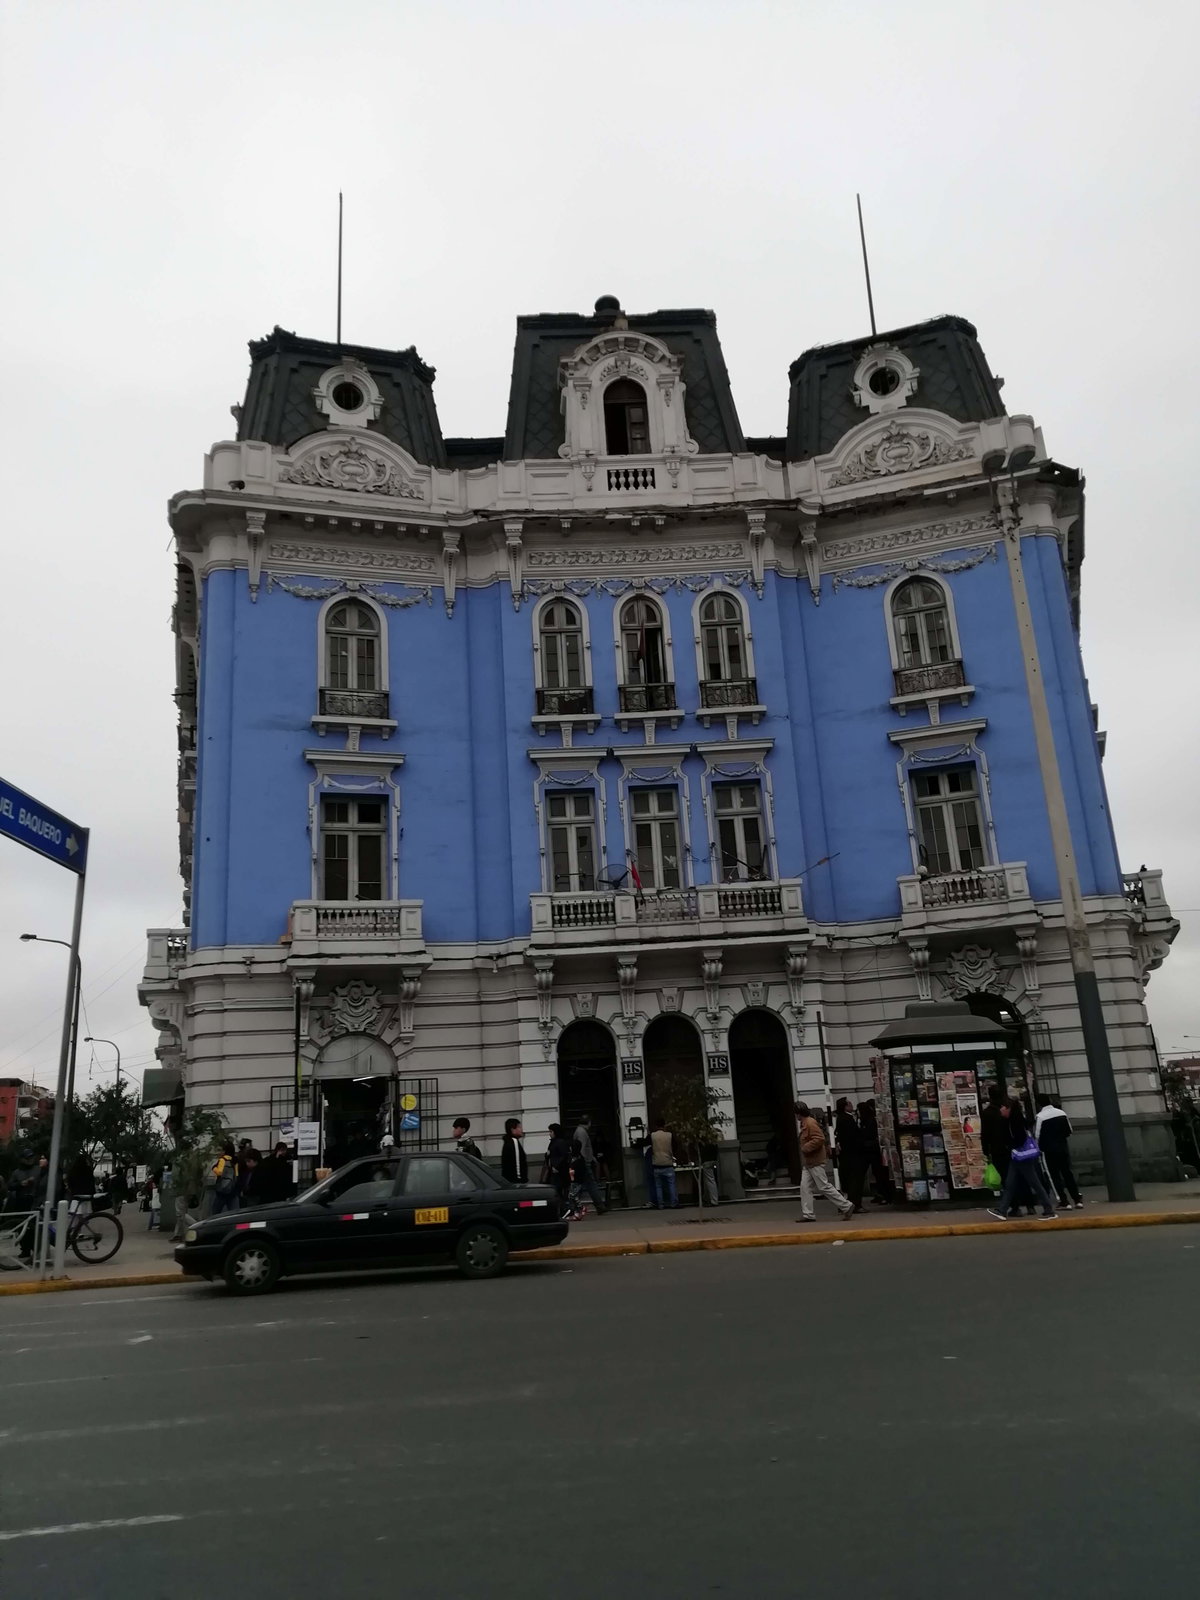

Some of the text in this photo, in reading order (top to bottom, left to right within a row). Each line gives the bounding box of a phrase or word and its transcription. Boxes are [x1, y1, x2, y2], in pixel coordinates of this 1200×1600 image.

[18, 807, 62, 845] BAQUERO
[624, 1062, 642, 1074] HS
[709, 1057, 727, 1069] HS
